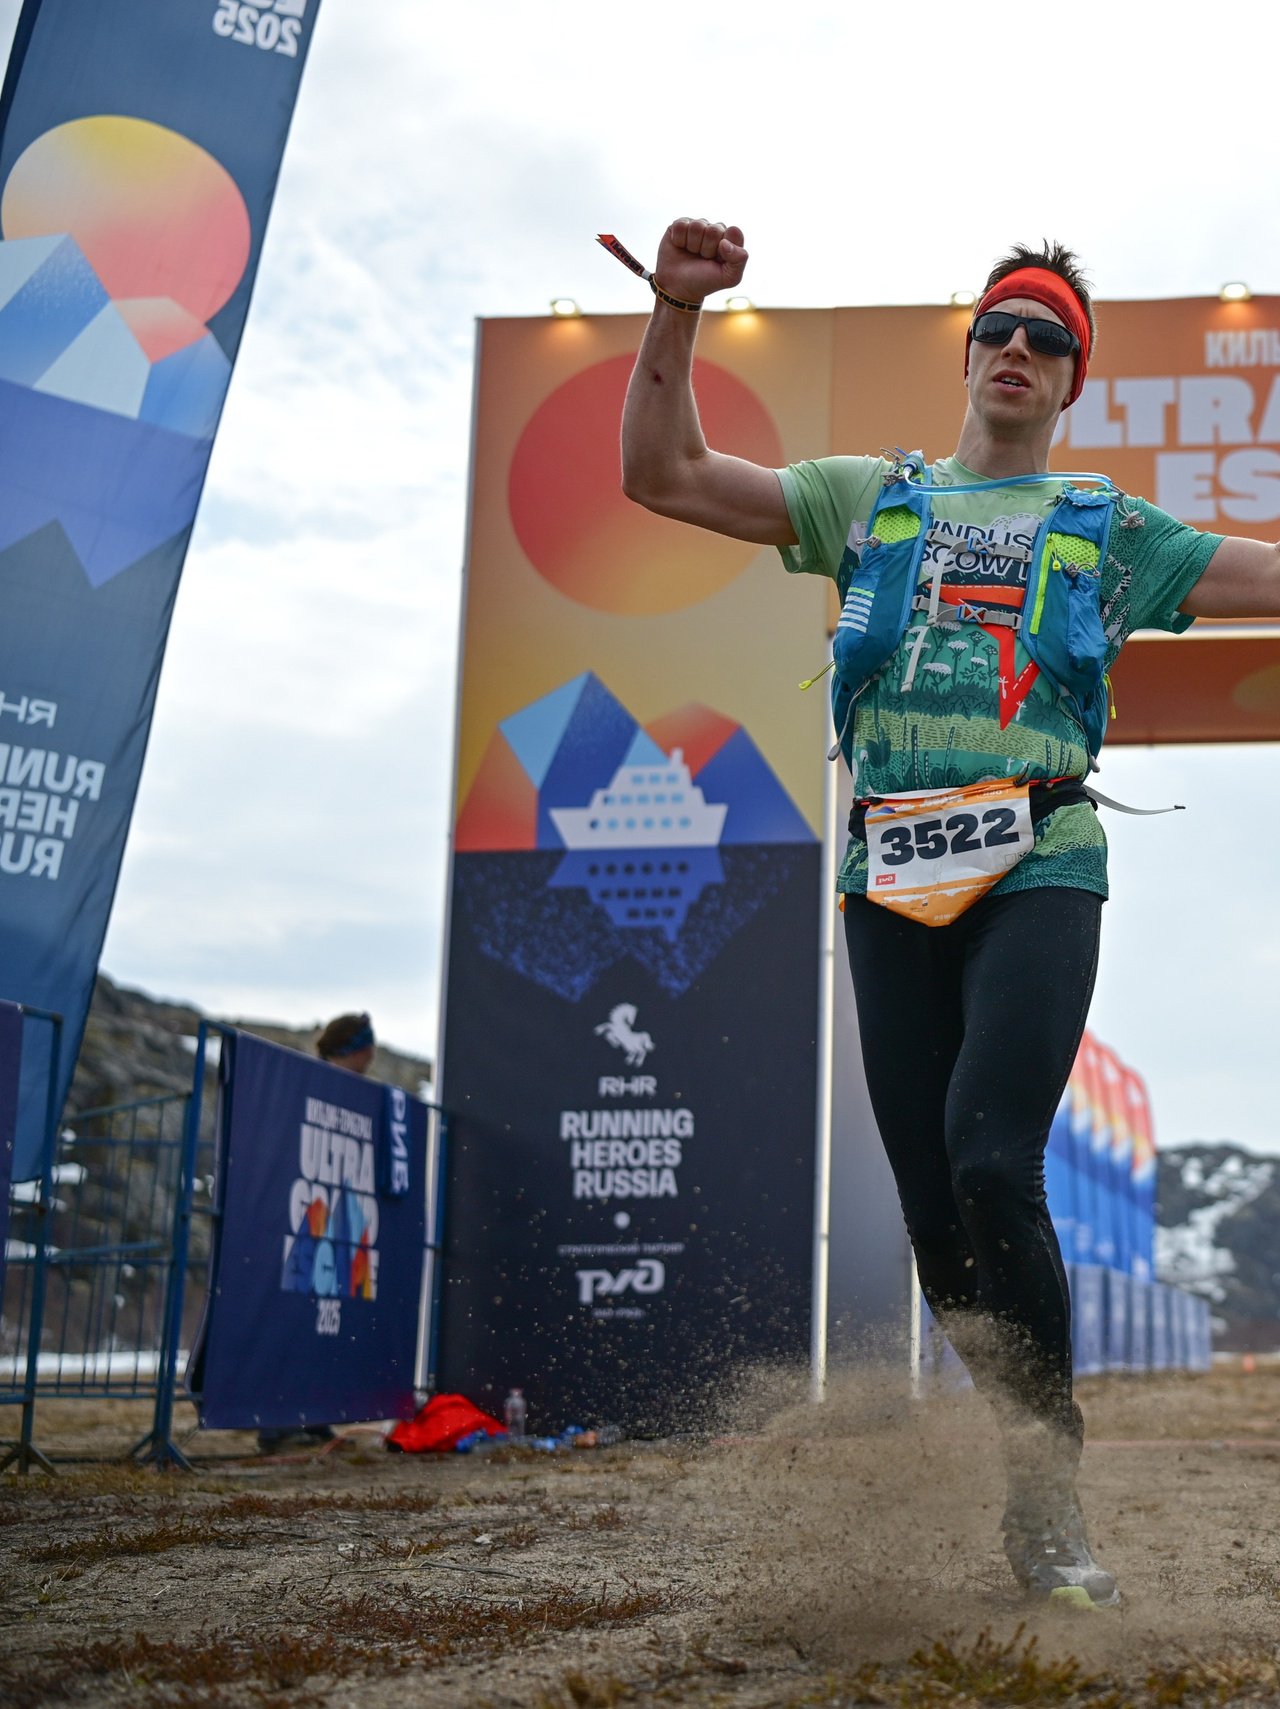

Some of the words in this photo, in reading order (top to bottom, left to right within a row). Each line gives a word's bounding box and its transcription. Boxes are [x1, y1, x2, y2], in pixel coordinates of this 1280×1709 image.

[880, 807, 1020, 866] 3522
[599, 1074, 658, 1098] RHR
[560, 1108, 695, 1141] RUNNING
[300, 1122, 376, 1196] ULTRA
[570, 1138, 684, 1170] HEROES
[572, 1168, 679, 1200] RUSSIA
